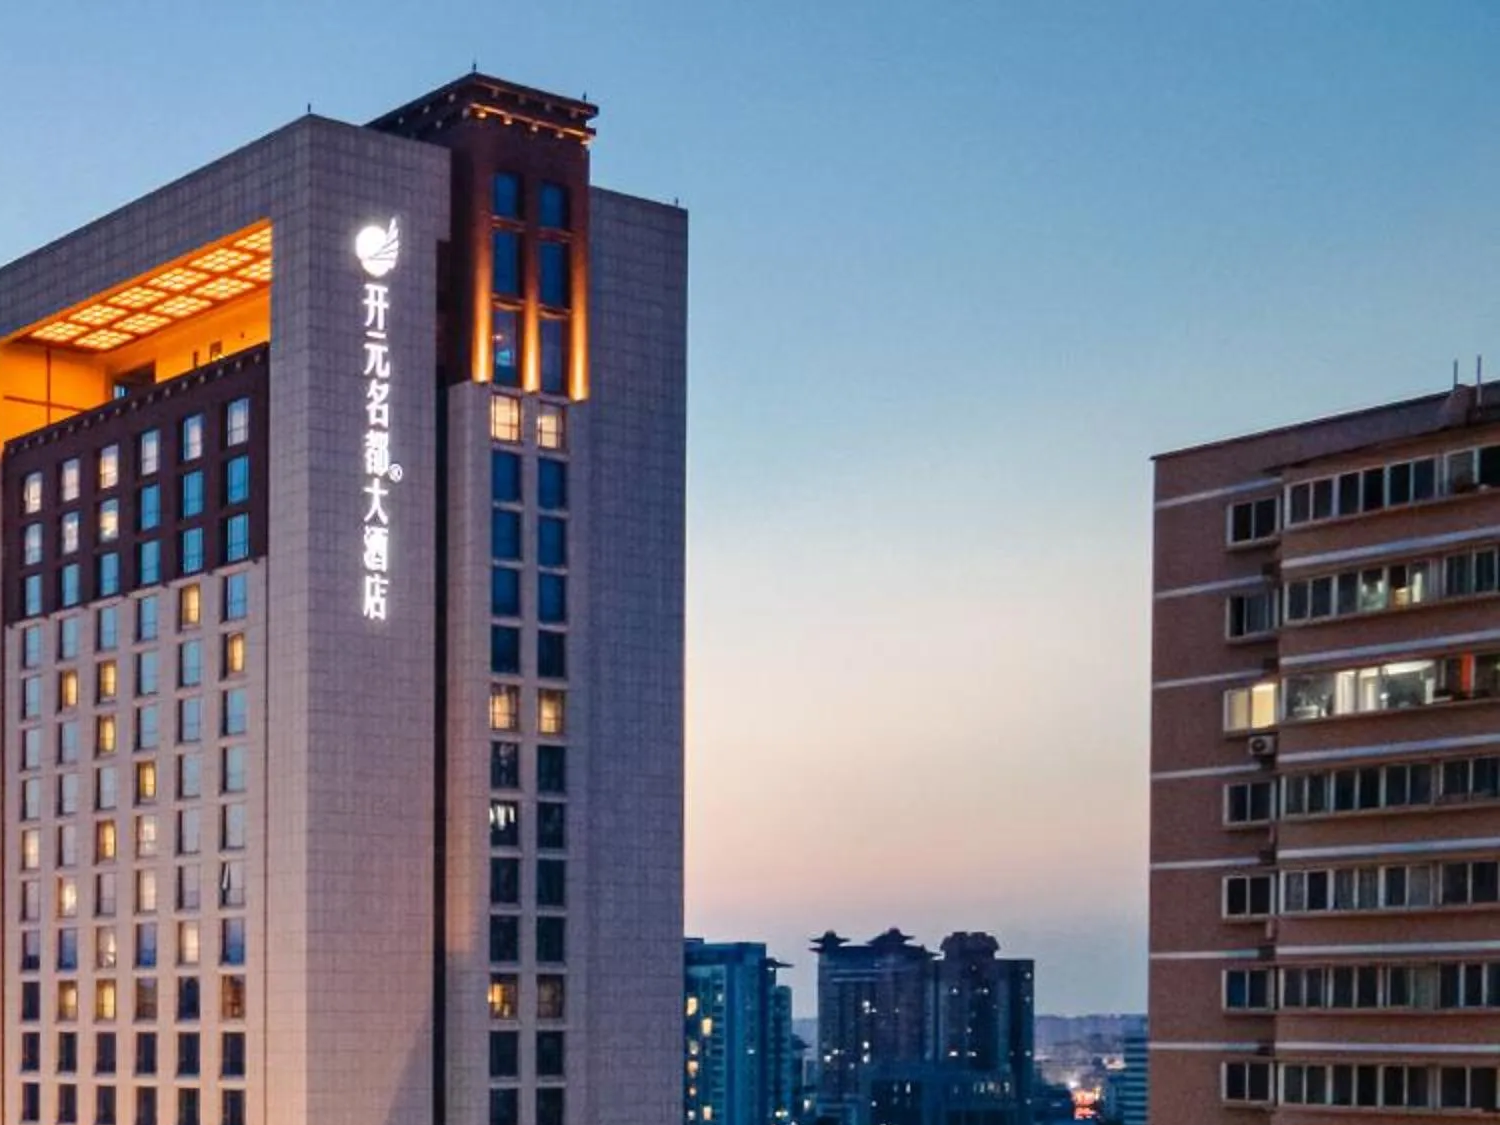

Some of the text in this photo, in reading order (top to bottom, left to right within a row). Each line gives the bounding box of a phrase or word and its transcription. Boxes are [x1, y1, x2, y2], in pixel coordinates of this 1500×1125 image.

[363, 283, 390, 620] 开元名都大酒店
